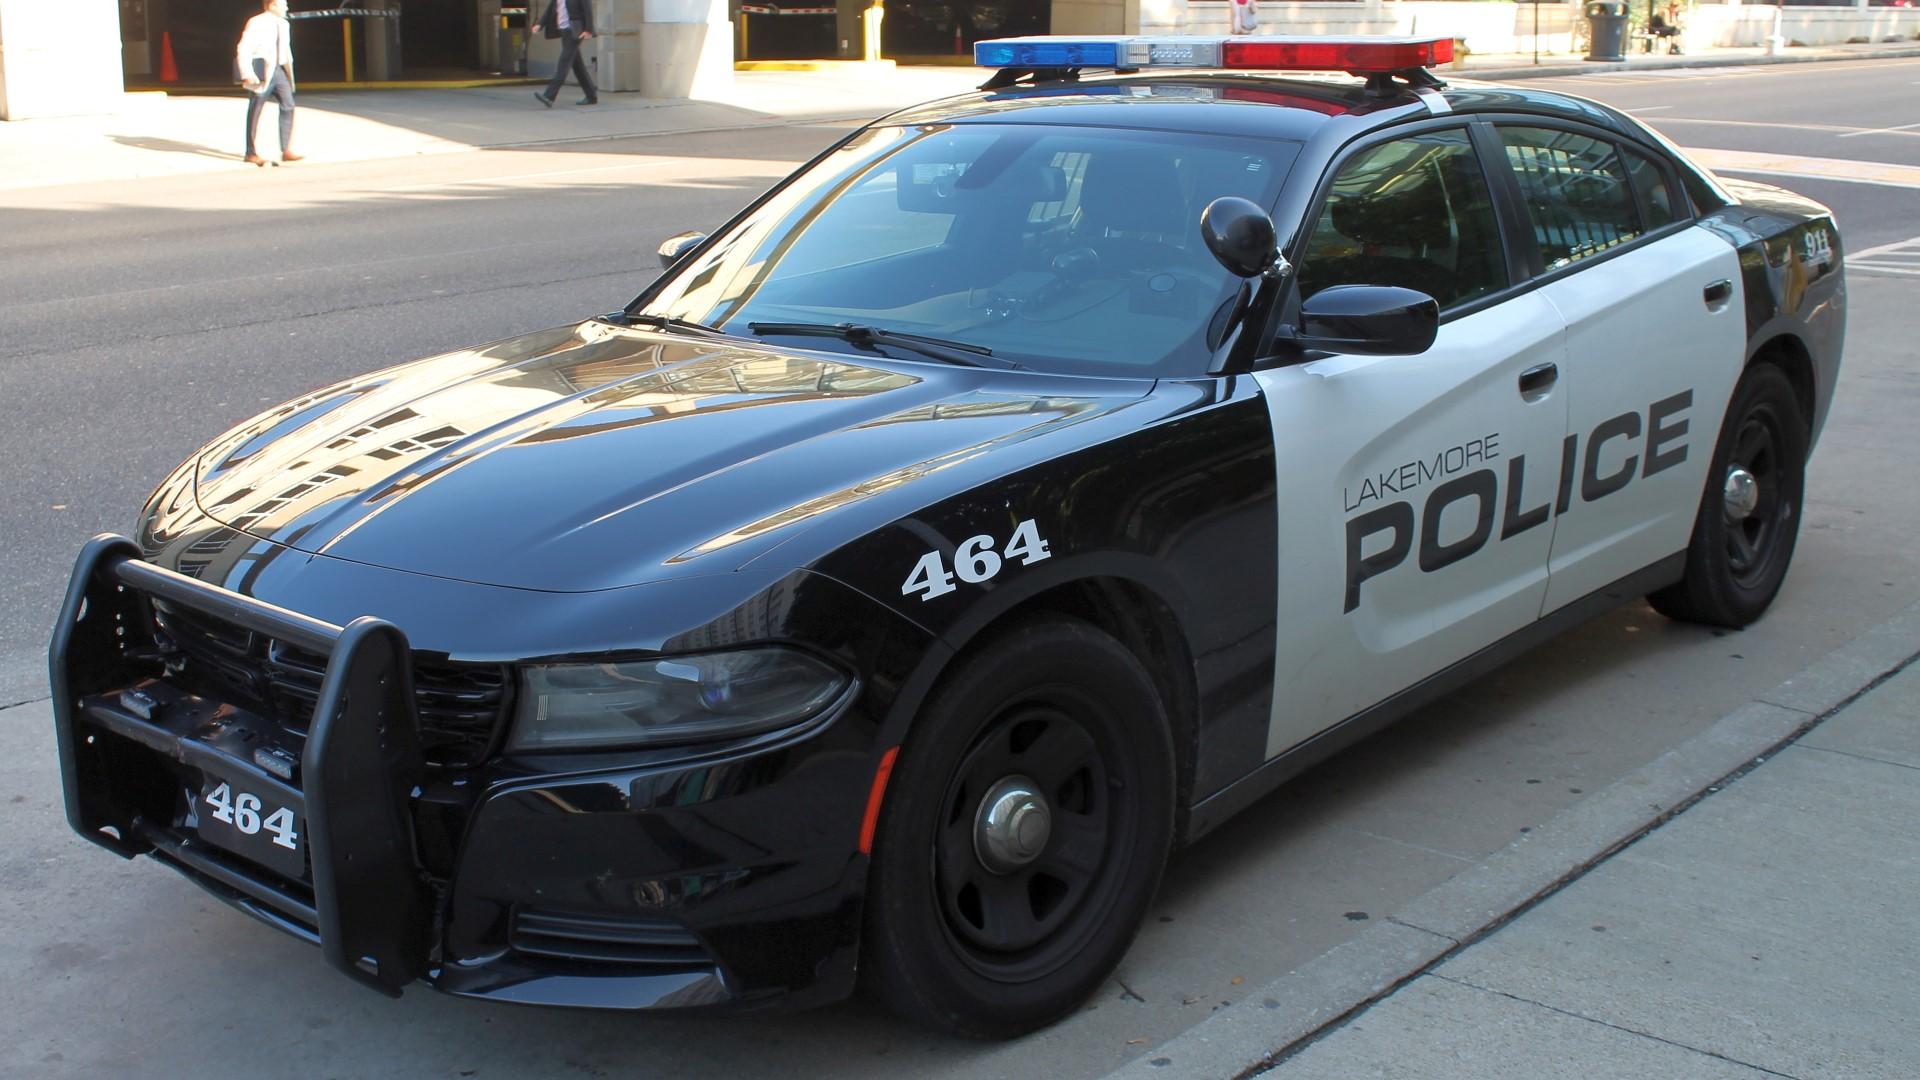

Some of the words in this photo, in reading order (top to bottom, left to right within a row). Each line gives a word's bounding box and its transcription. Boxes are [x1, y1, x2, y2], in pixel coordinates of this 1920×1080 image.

[1804, 229, 1829, 257] 911
[1343, 388, 1694, 615] POLICE
[1344, 432, 1500, 513] LAKEMORE
[901, 518, 1052, 602] 464
[206, 782, 298, 850] 464
